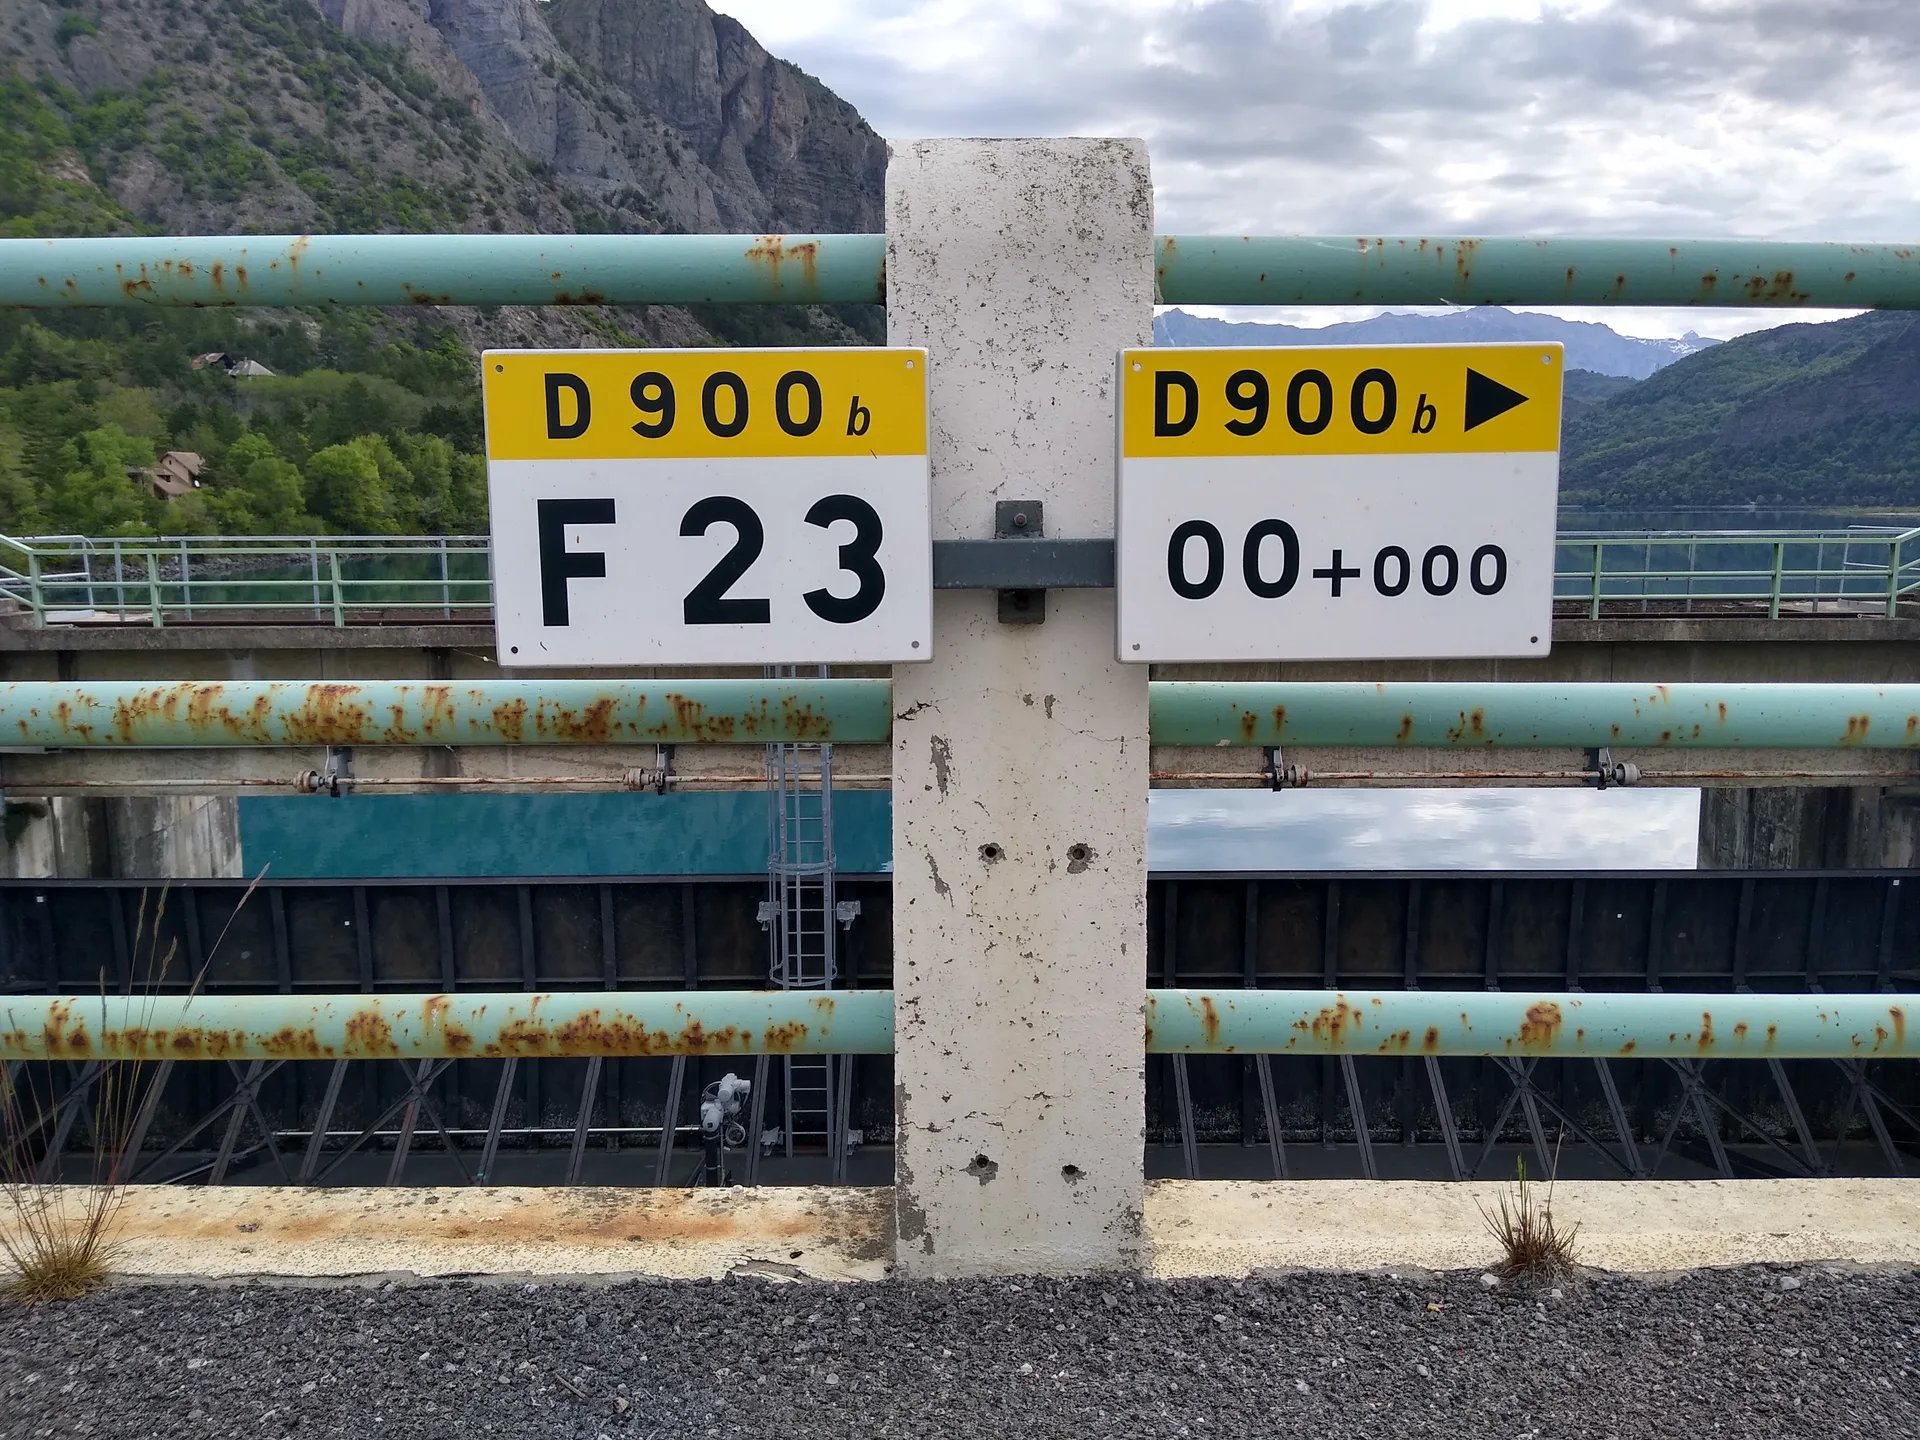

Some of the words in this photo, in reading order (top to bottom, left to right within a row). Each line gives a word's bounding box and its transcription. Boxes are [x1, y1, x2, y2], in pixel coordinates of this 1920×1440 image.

[544, 372, 592, 440] D
[1154, 370, 1199, 438] D
[536, 498, 617, 627] F
[679, 494, 886, 625] 23
